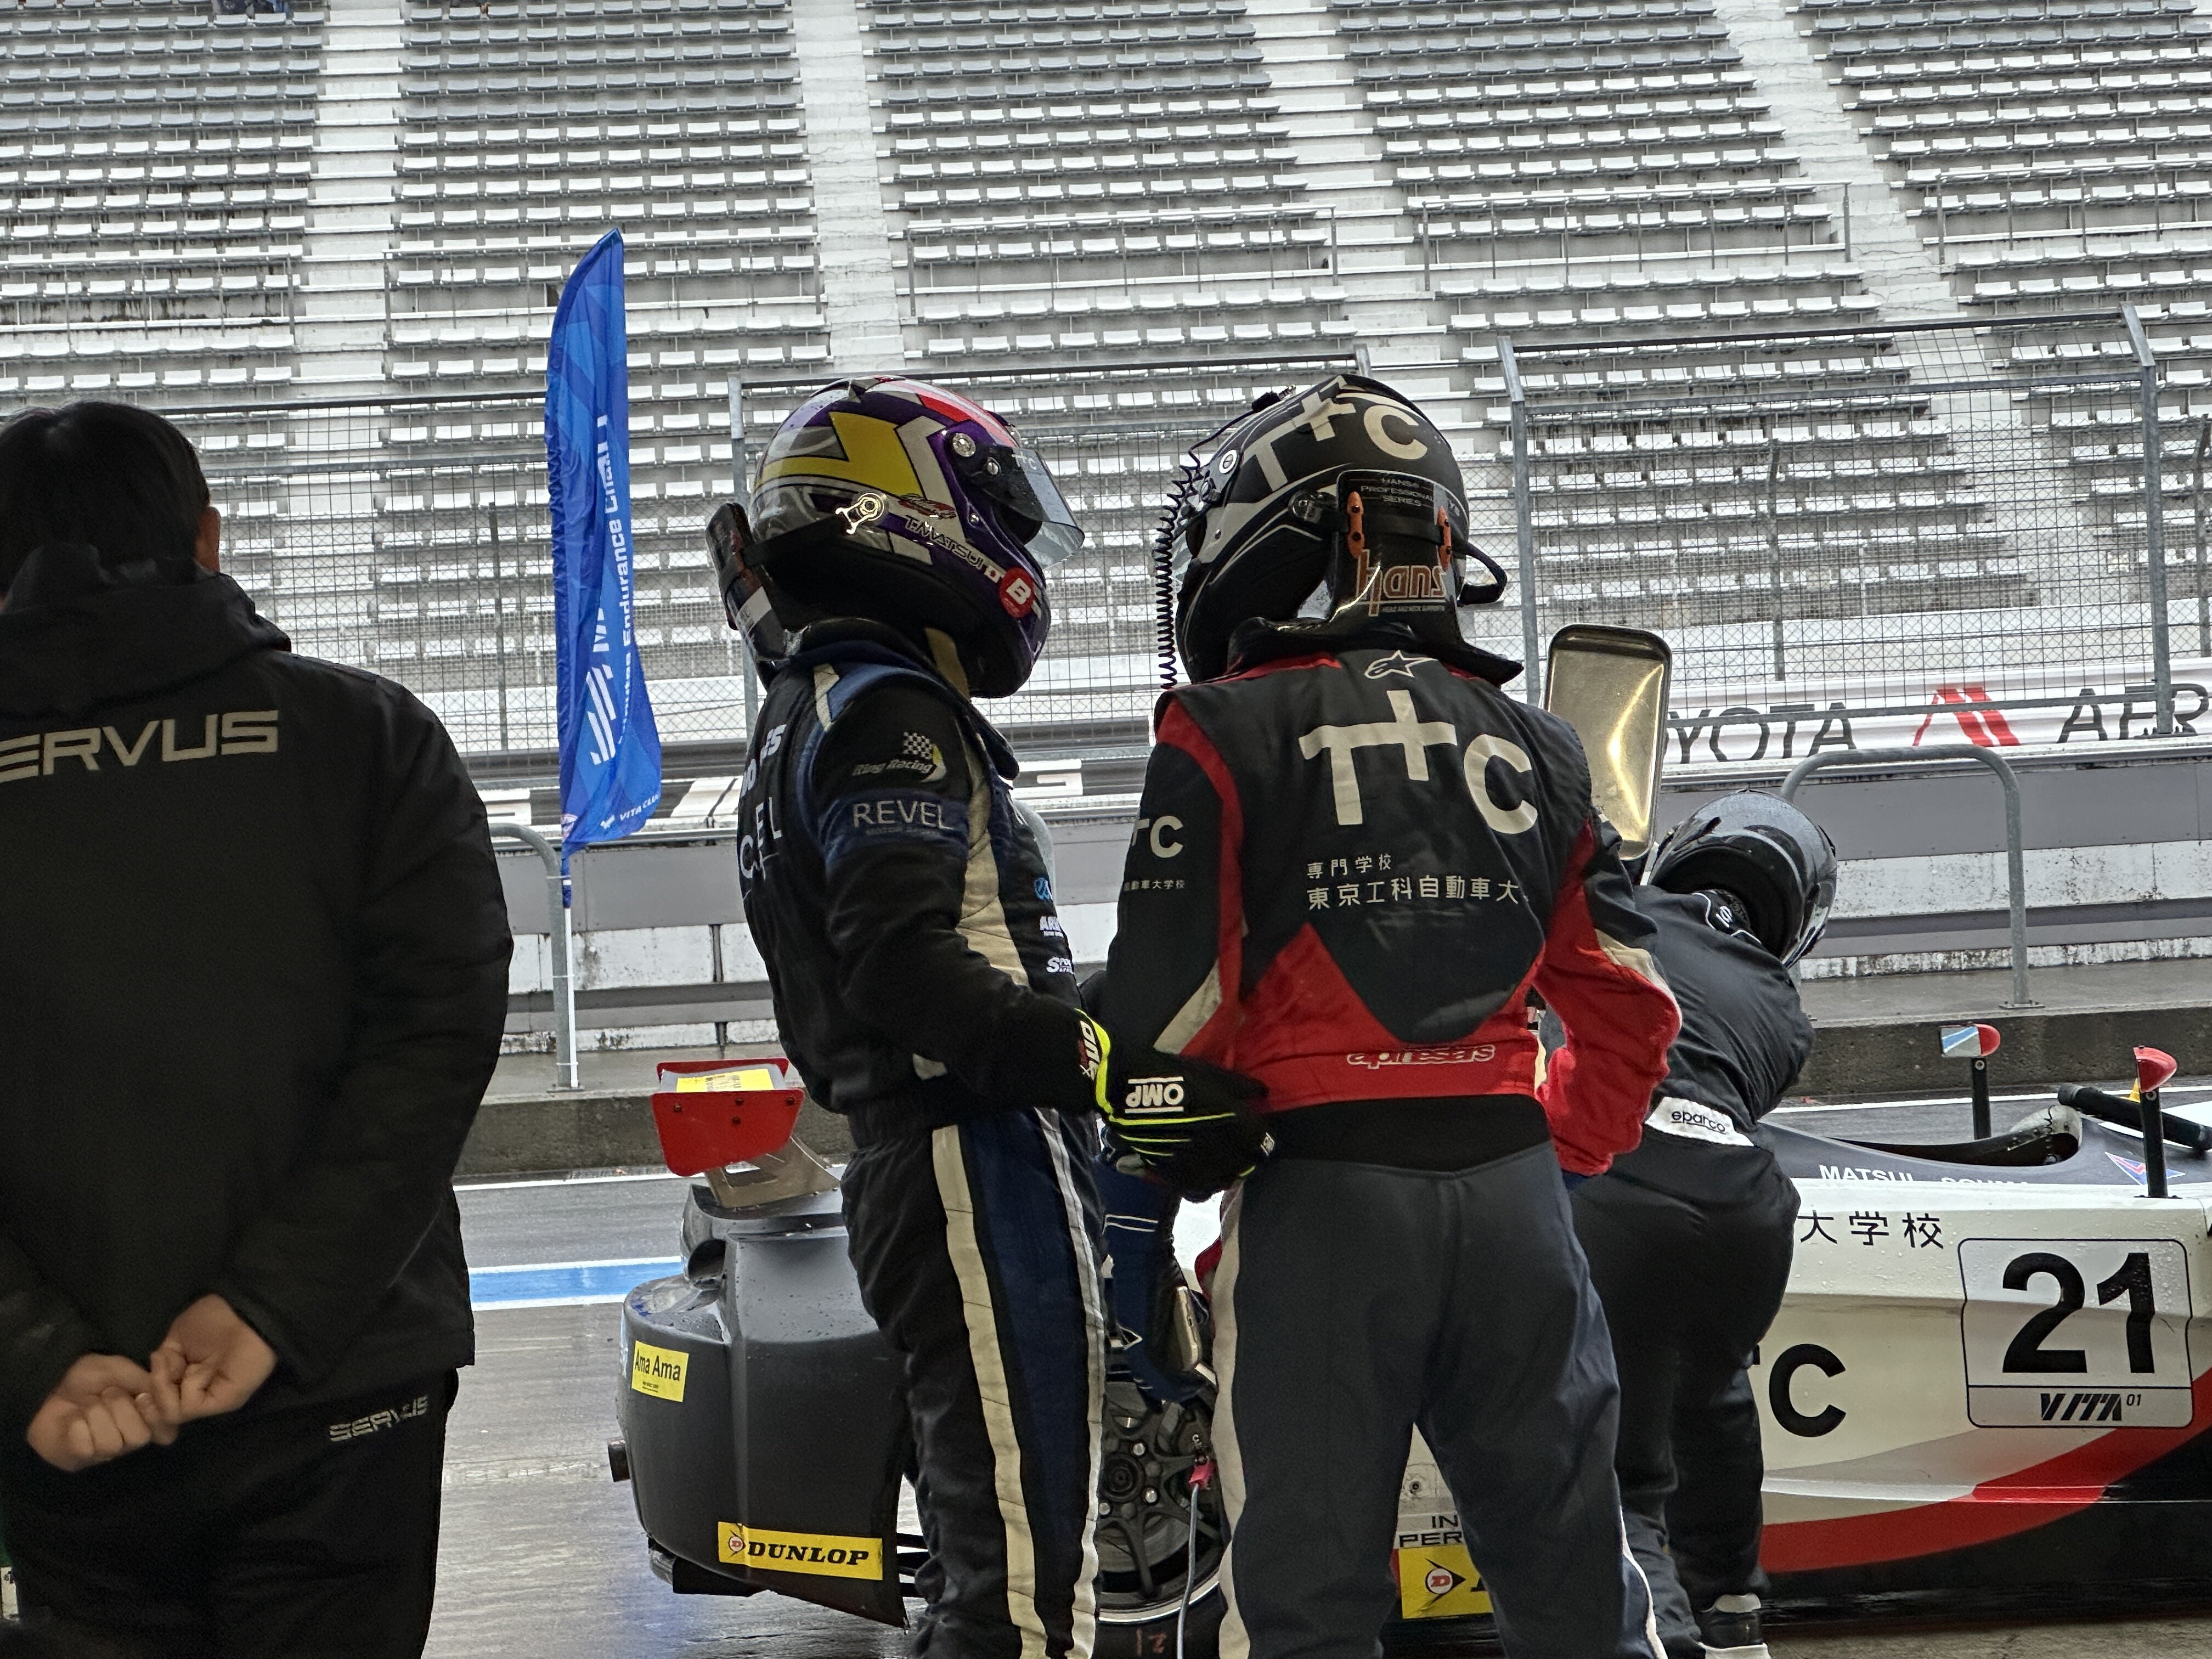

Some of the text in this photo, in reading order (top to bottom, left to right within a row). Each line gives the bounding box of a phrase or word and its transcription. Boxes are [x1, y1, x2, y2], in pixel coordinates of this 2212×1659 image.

[1361, 486, 1434, 501] PROFESSIONAL
[1382, 495, 1422, 507] SERIES
[608, 518, 631, 647] Endurance
[1666, 702, 1858, 765] YOTA
[853, 799, 954, 828] REVEL
[1126, 1082, 1184, 1109] OMP
[1797, 1210, 1944, 1249] 大学校
[2002, 1251, 2156, 1374] 21
[634, 1349, 681, 1381] Ama Ama
[2040, 1393, 2142, 1421] VITA 01
[748, 1541, 870, 1565] DUNLOP
